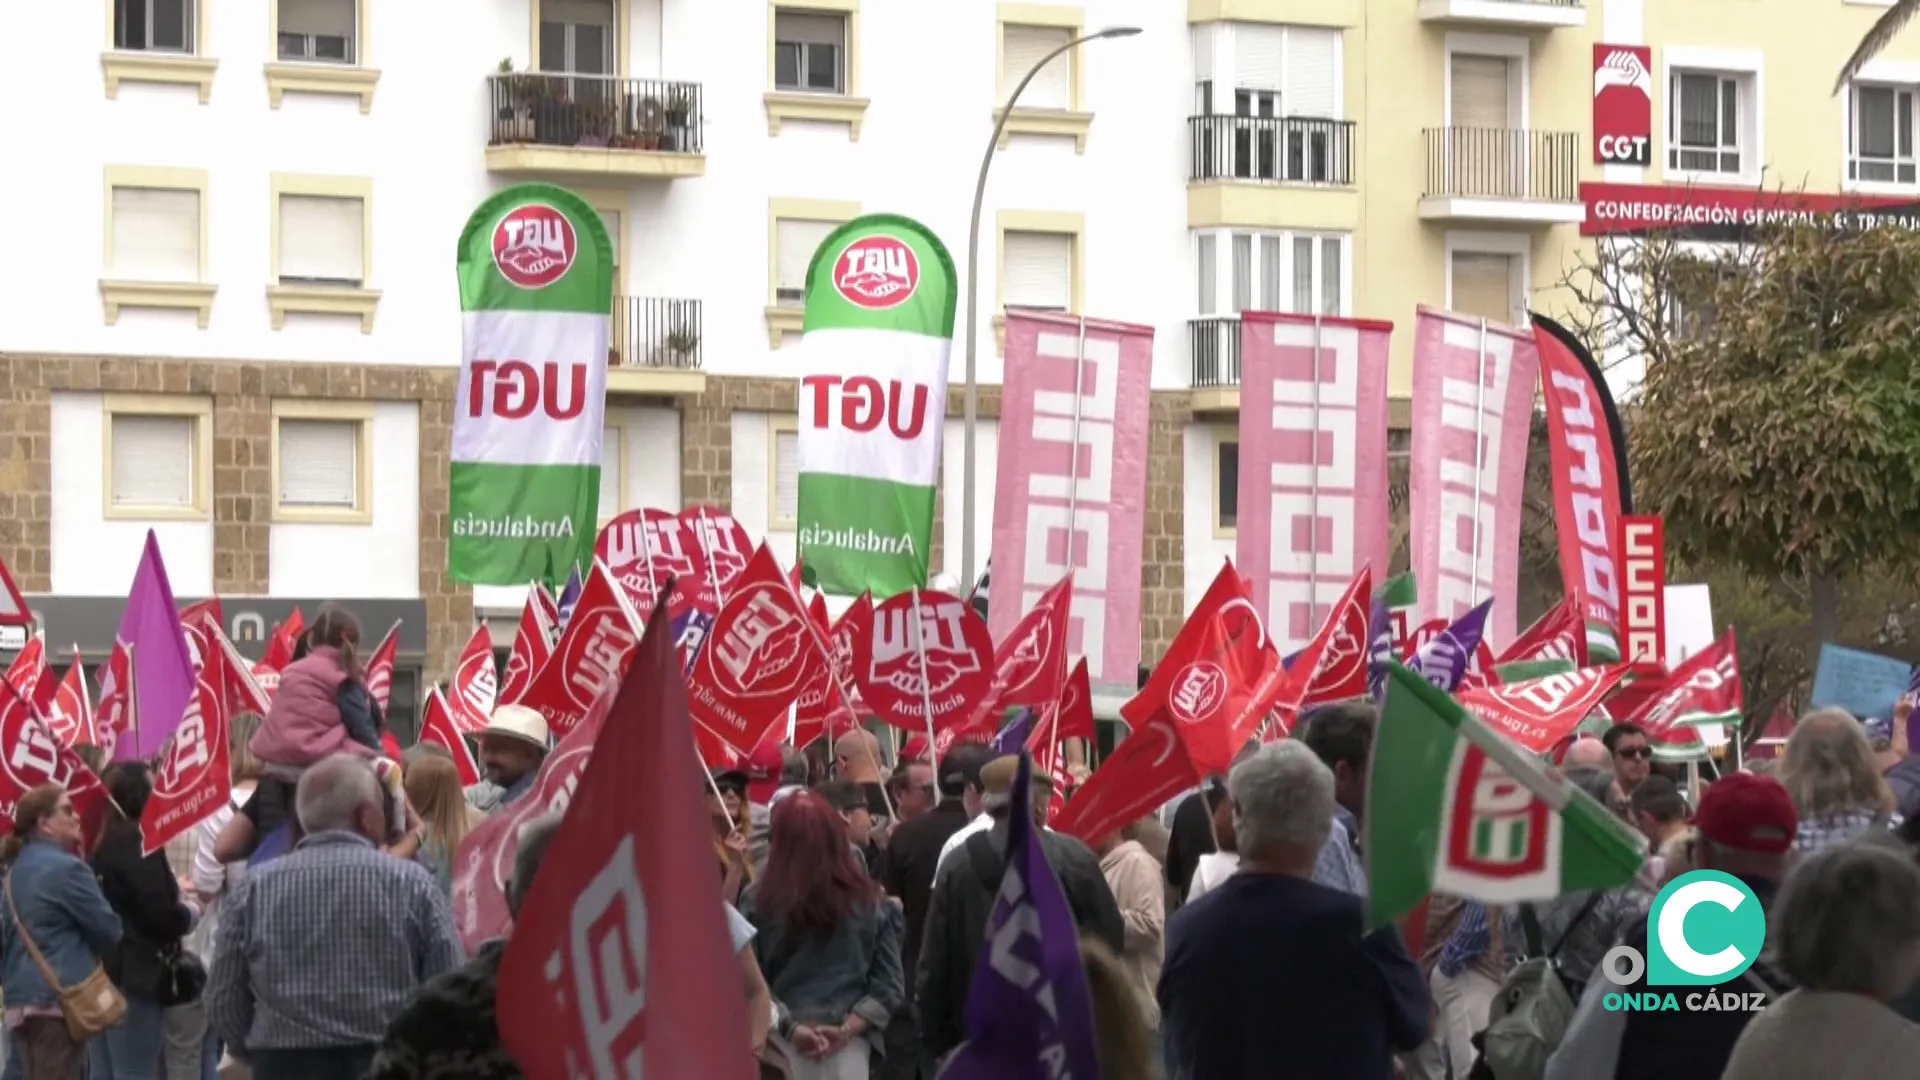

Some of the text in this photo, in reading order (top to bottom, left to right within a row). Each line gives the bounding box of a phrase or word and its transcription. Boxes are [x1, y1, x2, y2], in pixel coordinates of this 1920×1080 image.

[1599, 134, 1647, 161] CGT
[1595, 200, 1738, 225] CONFEDERACIÓN
[607, 518, 683, 568] UGT
[1625, 524, 1656, 663] CCOO
[716, 589, 793, 679] UGT
[873, 602, 969, 663] UGT
[1174, 667, 1212, 714] UGT
